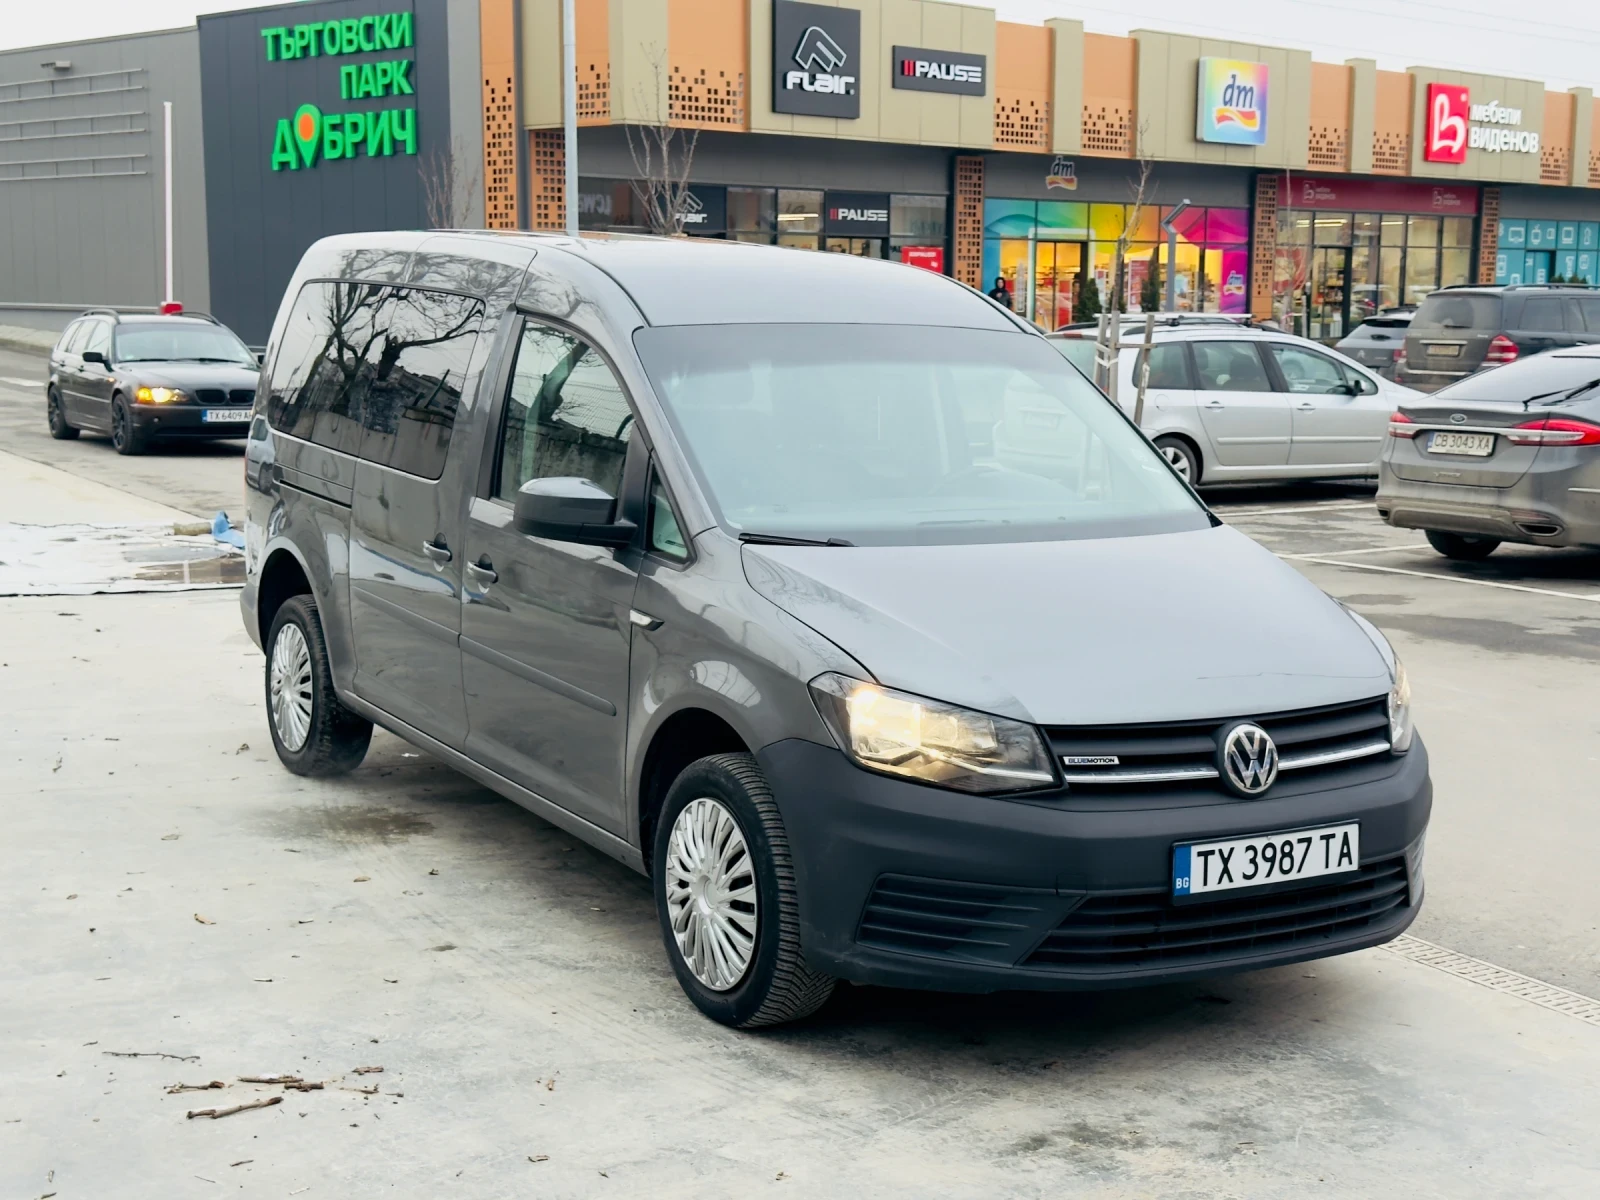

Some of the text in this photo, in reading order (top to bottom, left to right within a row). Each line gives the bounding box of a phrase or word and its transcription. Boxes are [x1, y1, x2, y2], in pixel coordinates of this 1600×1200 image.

[260, 11, 414, 61] ТЪРГОВСКИ
[339, 59, 414, 100] ПАРК
[1223, 74, 1254, 109] dm
[1469, 99, 1522, 126] мебели
[1052, 156, 1073, 177] dm
[1434, 434, 1490, 450] CB 3043 XA
[1197, 831, 1353, 887] TX 3987 TA
[1175, 876, 1190, 889] BG
